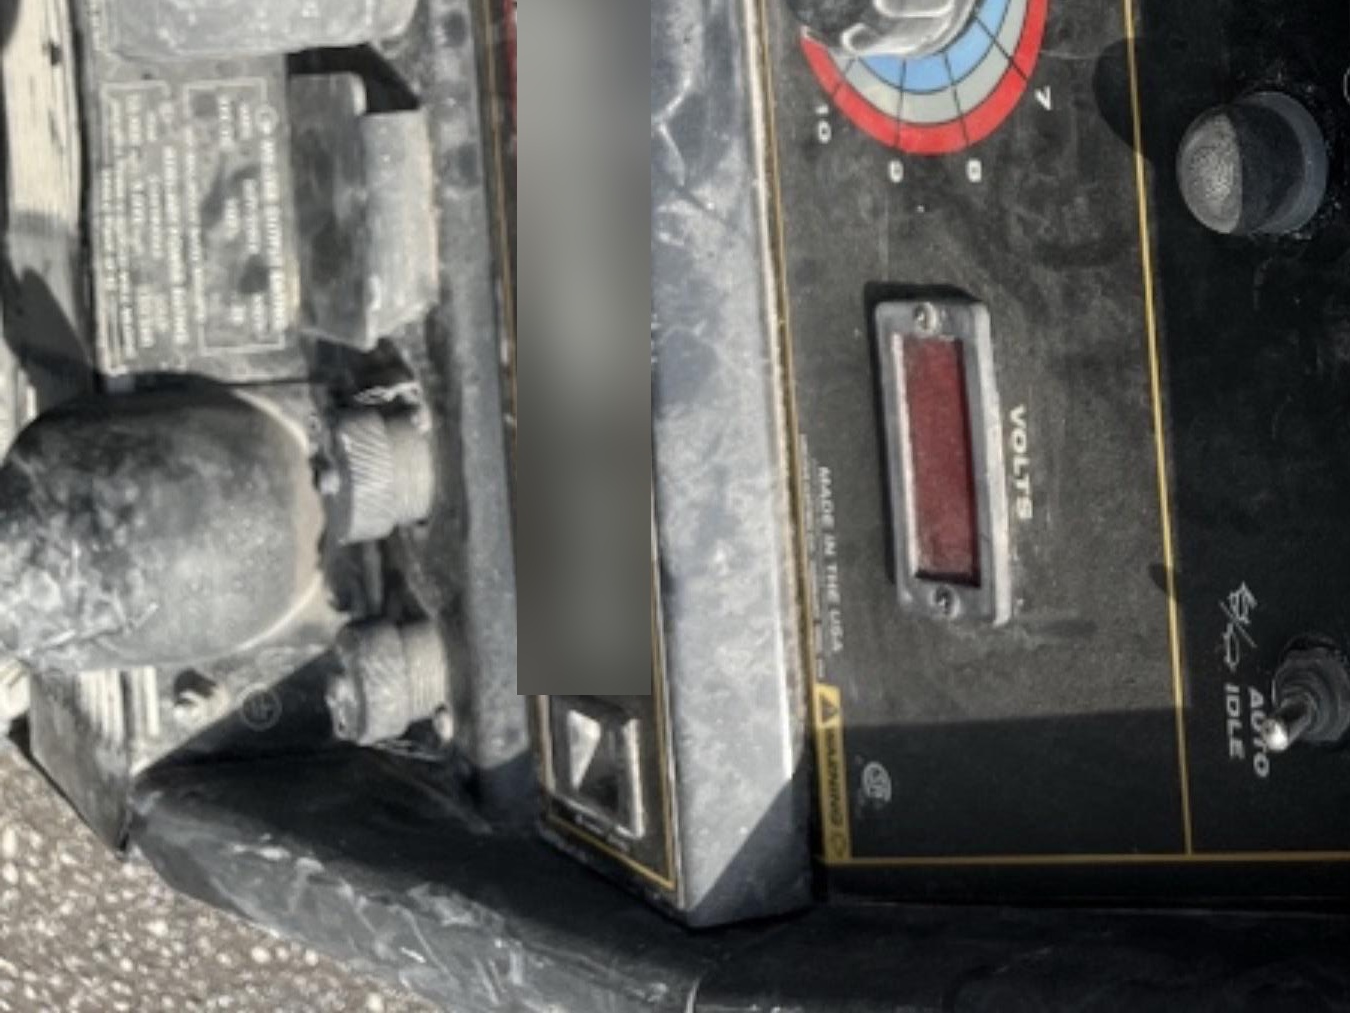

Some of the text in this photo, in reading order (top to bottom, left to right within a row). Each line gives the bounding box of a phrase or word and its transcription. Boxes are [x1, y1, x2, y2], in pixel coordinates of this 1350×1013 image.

[815, 104, 832, 144] 10
[1034, 85, 1052, 112] 7
[1009, 403, 1034, 520] VOLTS
[817, 466, 844, 653] MADE IN THE USA
[1224, 682, 1245, 760] IDLE
